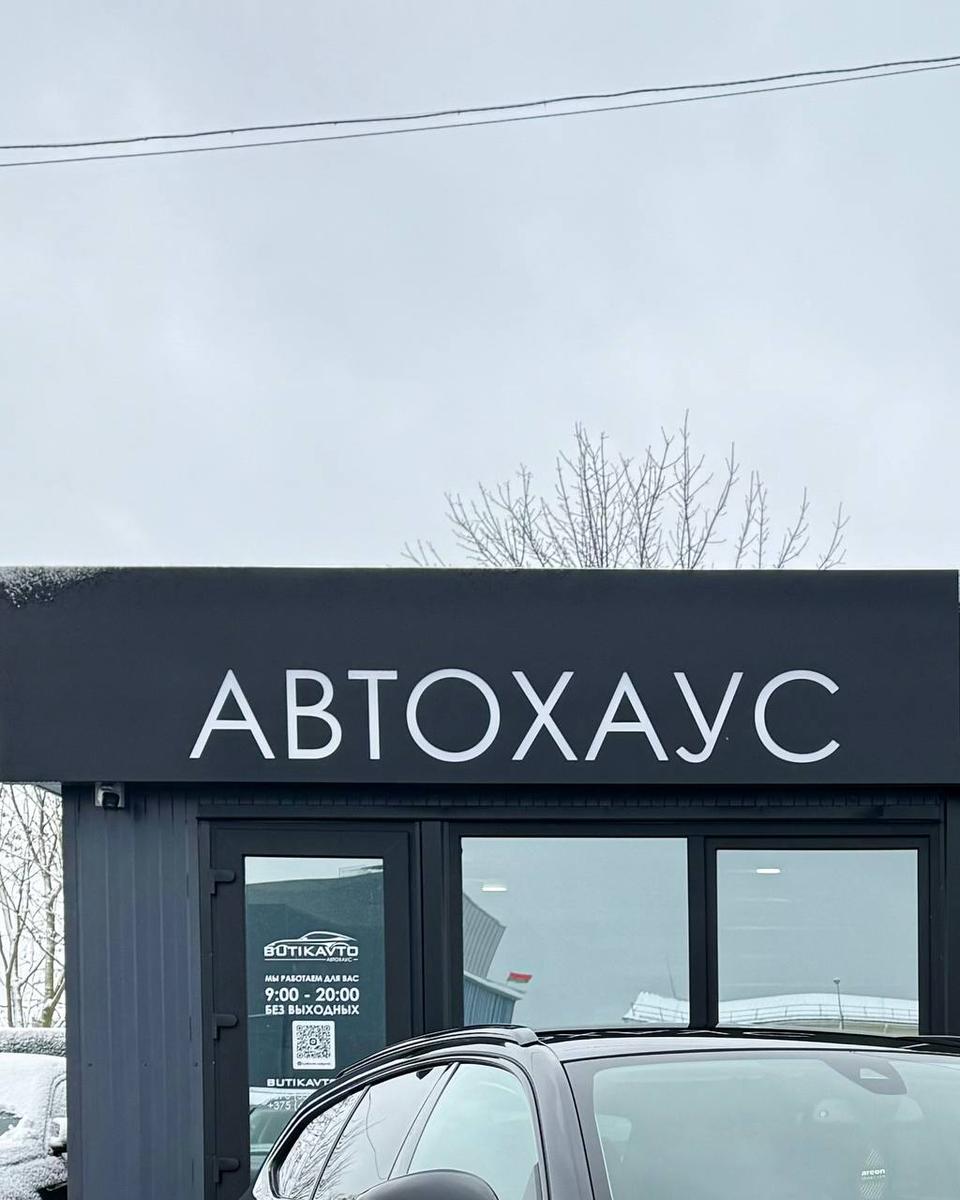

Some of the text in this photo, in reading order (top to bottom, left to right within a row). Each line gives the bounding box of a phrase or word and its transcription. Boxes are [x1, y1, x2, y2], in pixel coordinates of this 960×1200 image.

[189, 668, 842, 764] АВТОХАУС
[264, 946, 358, 957] BUTIKAVTO
[264, 974, 360, 984] МЫ РАБОТАЕМ ДЛЯ ВАС
[264, 986, 300, 1002] 9:00
[315, 986, 360, 1002] 20:00
[264, 1004, 360, 1016] БЕЗ ВЫХОДНЫХ
[861, 1168, 885, 1176] areon
